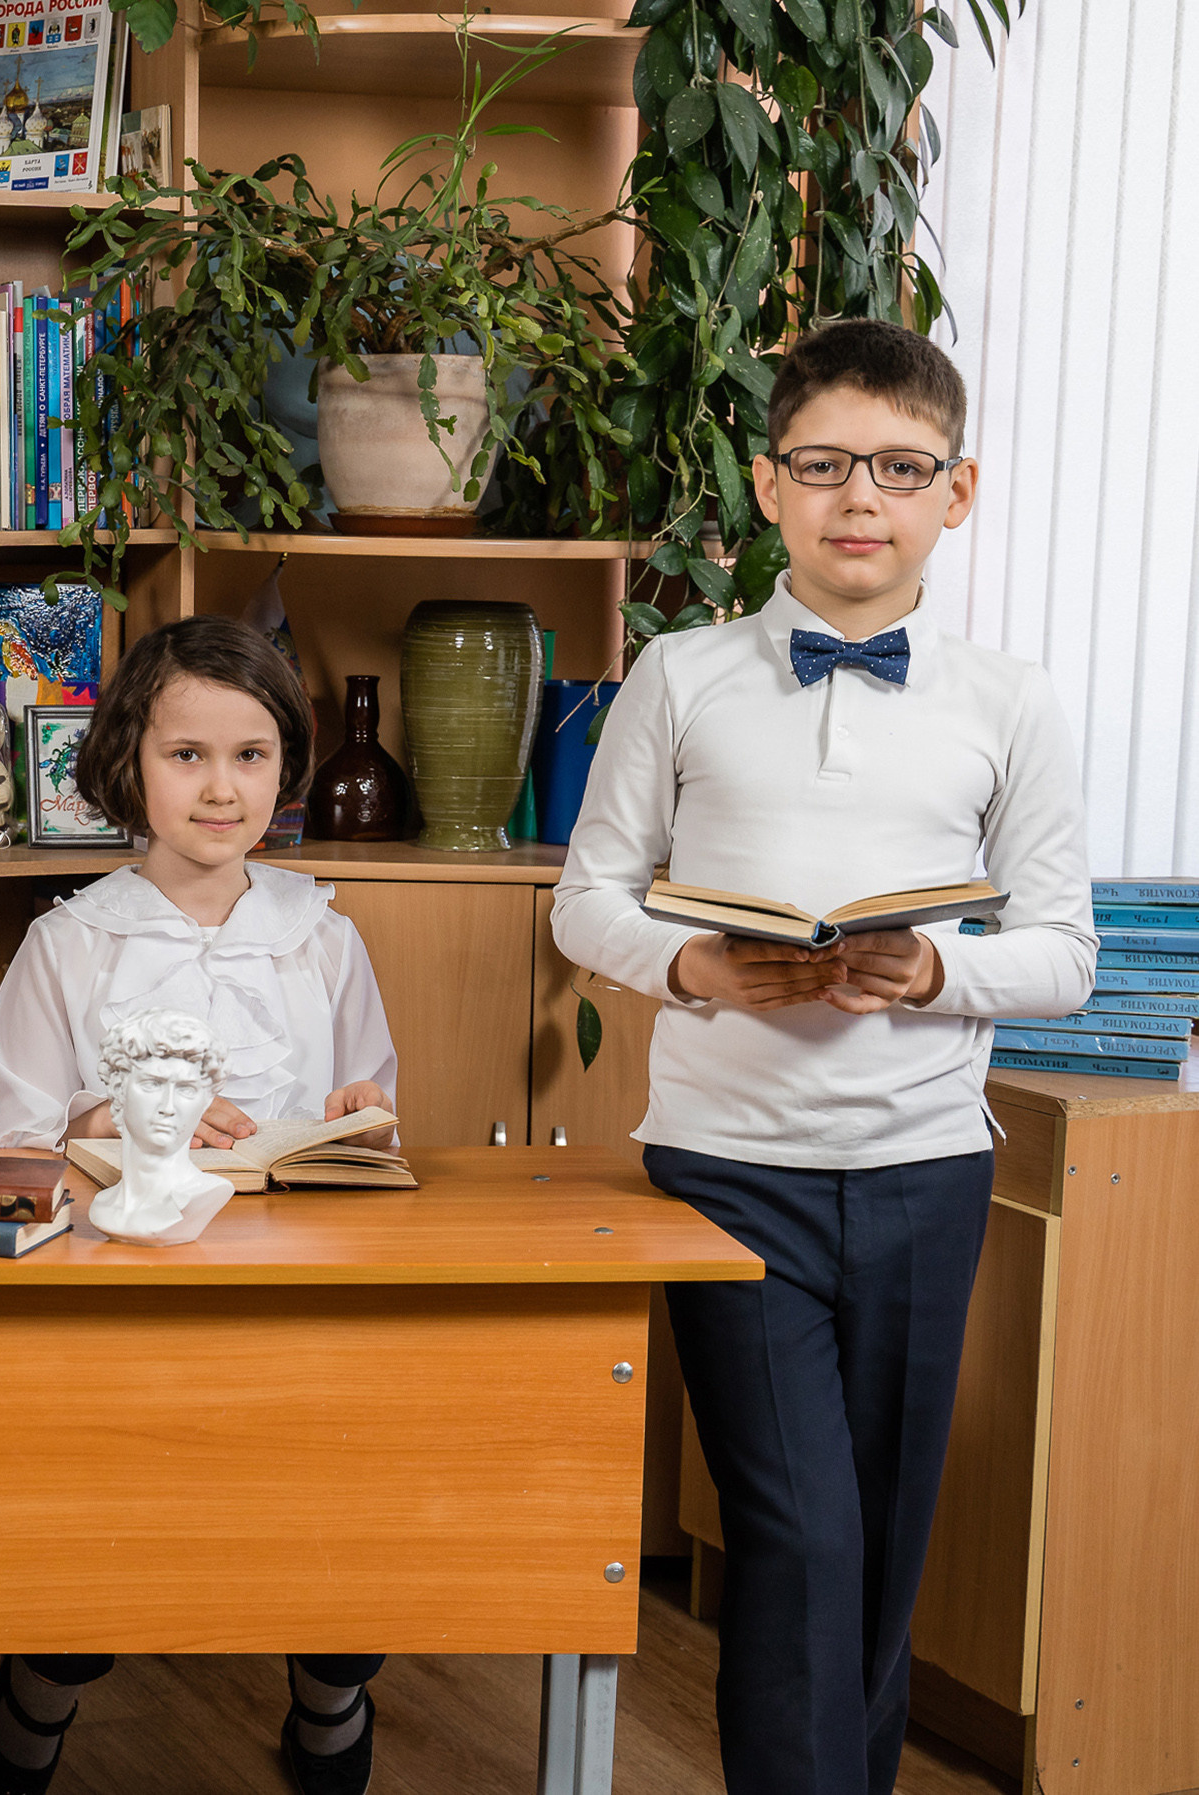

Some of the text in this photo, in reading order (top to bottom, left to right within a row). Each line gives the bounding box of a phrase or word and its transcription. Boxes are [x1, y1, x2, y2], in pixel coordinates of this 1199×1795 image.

[39, 332, 47, 402] САНКТ-ПЕТЕРБУРГЕ
[62, 331, 71, 420] ОБРАЯ МАТЕМАТИКА
[39, 413, 47, 438] ДЕТЯМ
[41, 794, 89, 825] Мар
[1135, 888, 1199, 898] ЕСТОМАТИЯ.
[1121, 954, 1199, 964] РЕСТОМАТИЯ.
[1144, 977, 1199, 988] ТОМАТИЯ.
[1117, 999, 1199, 1013] ХРЕСТОМАТИЯ.
[1098, 1018, 1180, 1033] ХРЕСТОМАТИЯ.
[990, 1056, 1072, 1069] РЕСТОМАТИЯ.
